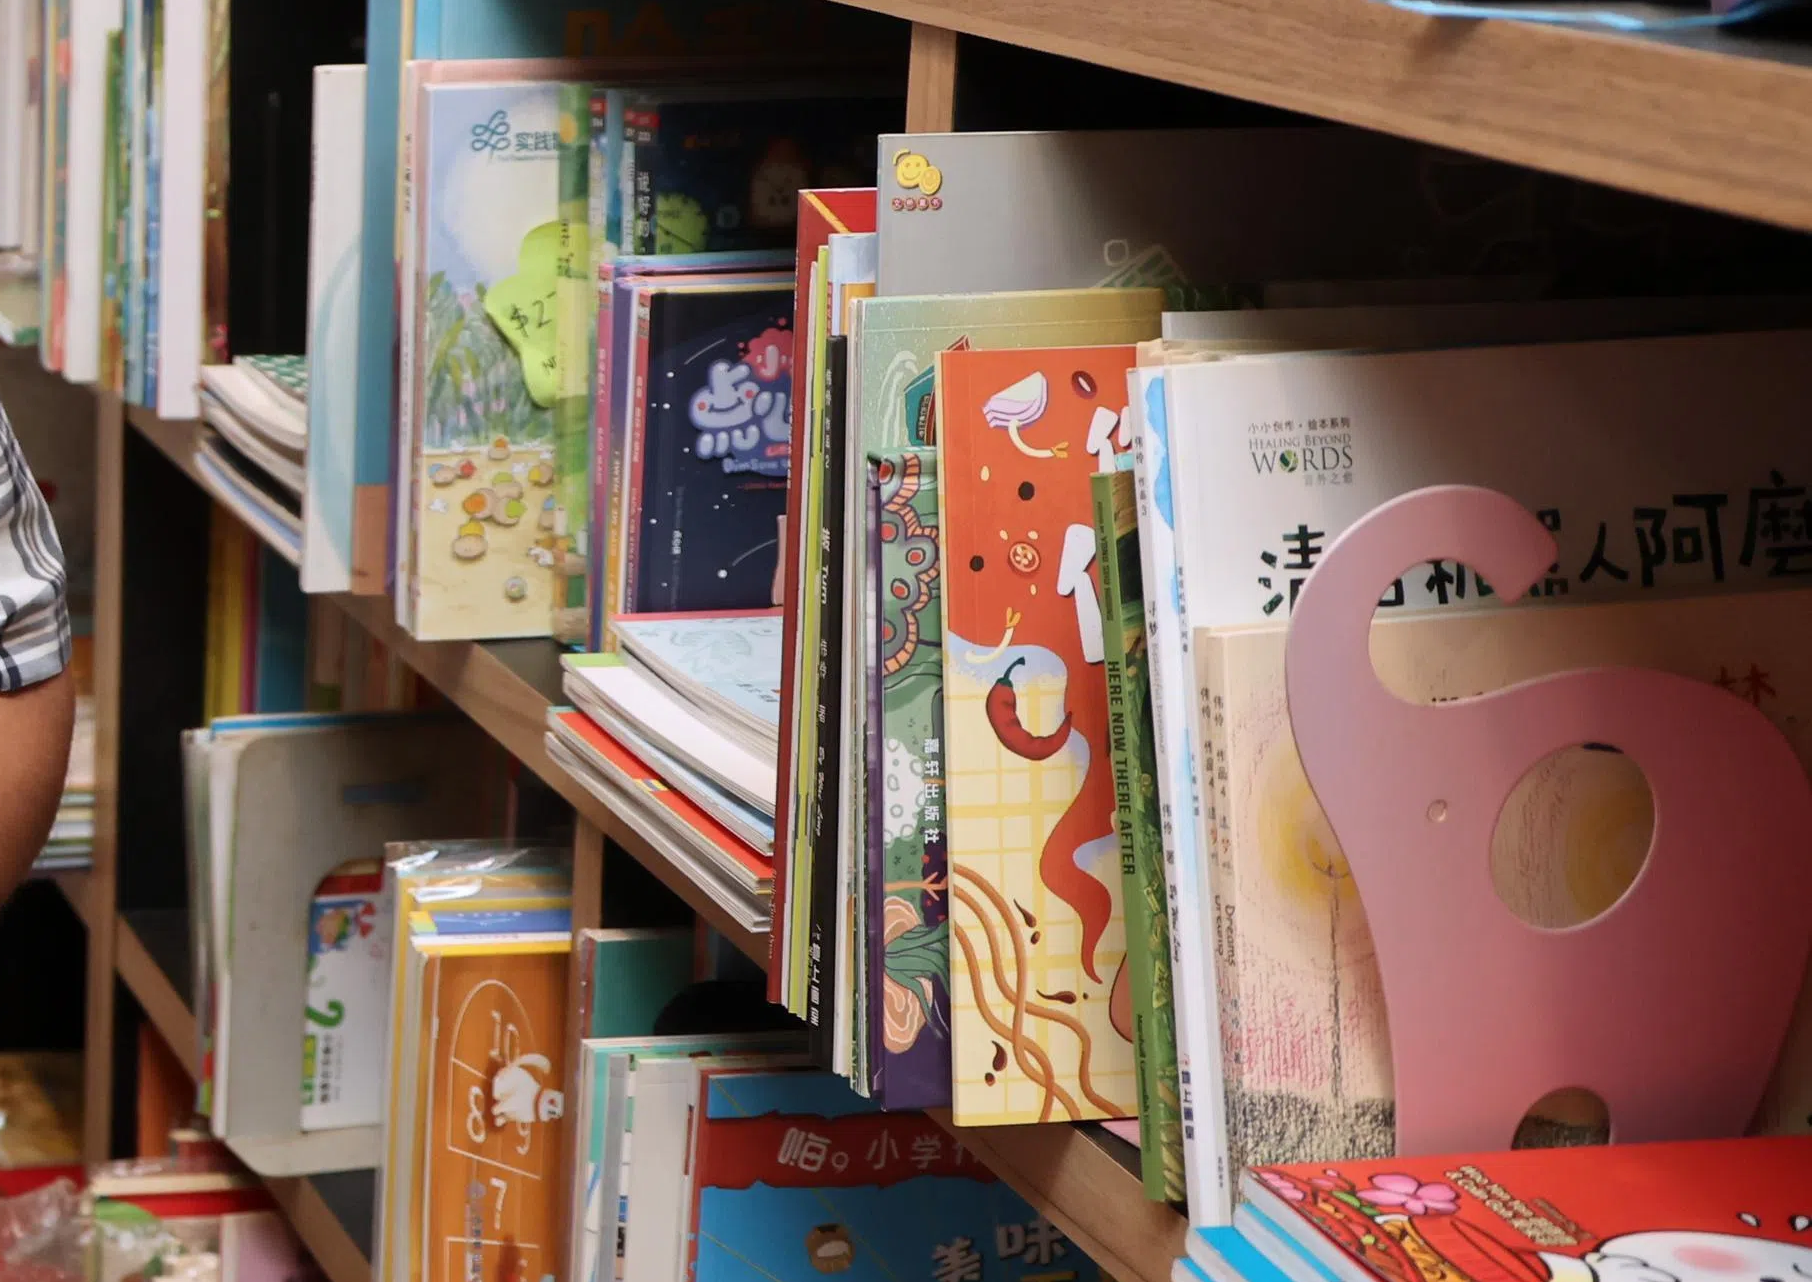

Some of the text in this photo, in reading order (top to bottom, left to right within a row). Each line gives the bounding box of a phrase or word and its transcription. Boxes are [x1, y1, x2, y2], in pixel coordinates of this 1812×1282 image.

[1249, 432, 1352, 451] HEALING BEYOND
[1252, 445, 1354, 475] WORDS
[924, 738, 940, 844] 嘉轩出版社
[1107, 660, 1135, 876] HERE NOW THERE AFTER
